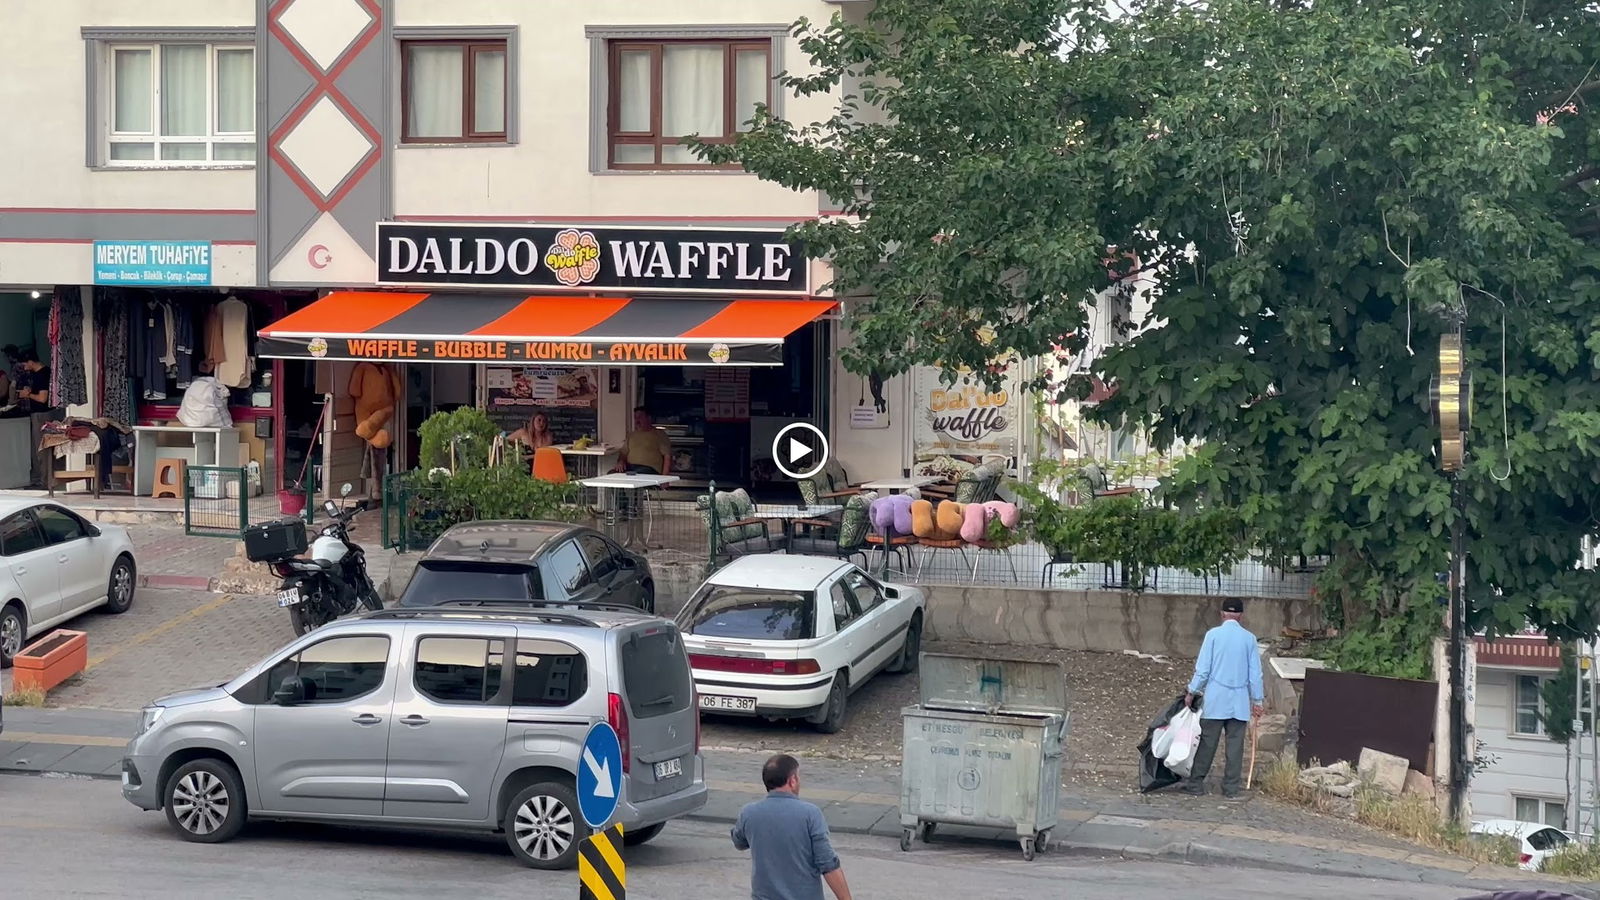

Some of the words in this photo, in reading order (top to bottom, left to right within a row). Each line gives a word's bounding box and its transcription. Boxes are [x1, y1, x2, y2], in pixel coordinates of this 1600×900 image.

[97, 245, 147, 265] MERYEM
[388, 237, 538, 275] DALDO
[547, 244, 598, 269] Waffle
[609, 240, 791, 282] WAFFLE
[121, 270, 140, 280] Boncuk
[143, 270, 163, 281] Bileklik
[347, 339, 417, 359] WAFFLE
[435, 341, 507, 359] BUBBLE
[525, 342, 592, 361] KUMRU
[609, 343, 687, 361] AYVALIK
[933, 408, 1008, 439] waffle
[703, 696, 716, 707] 06
[721, 697, 733, 708] FE
[736, 698, 754, 709] 387
